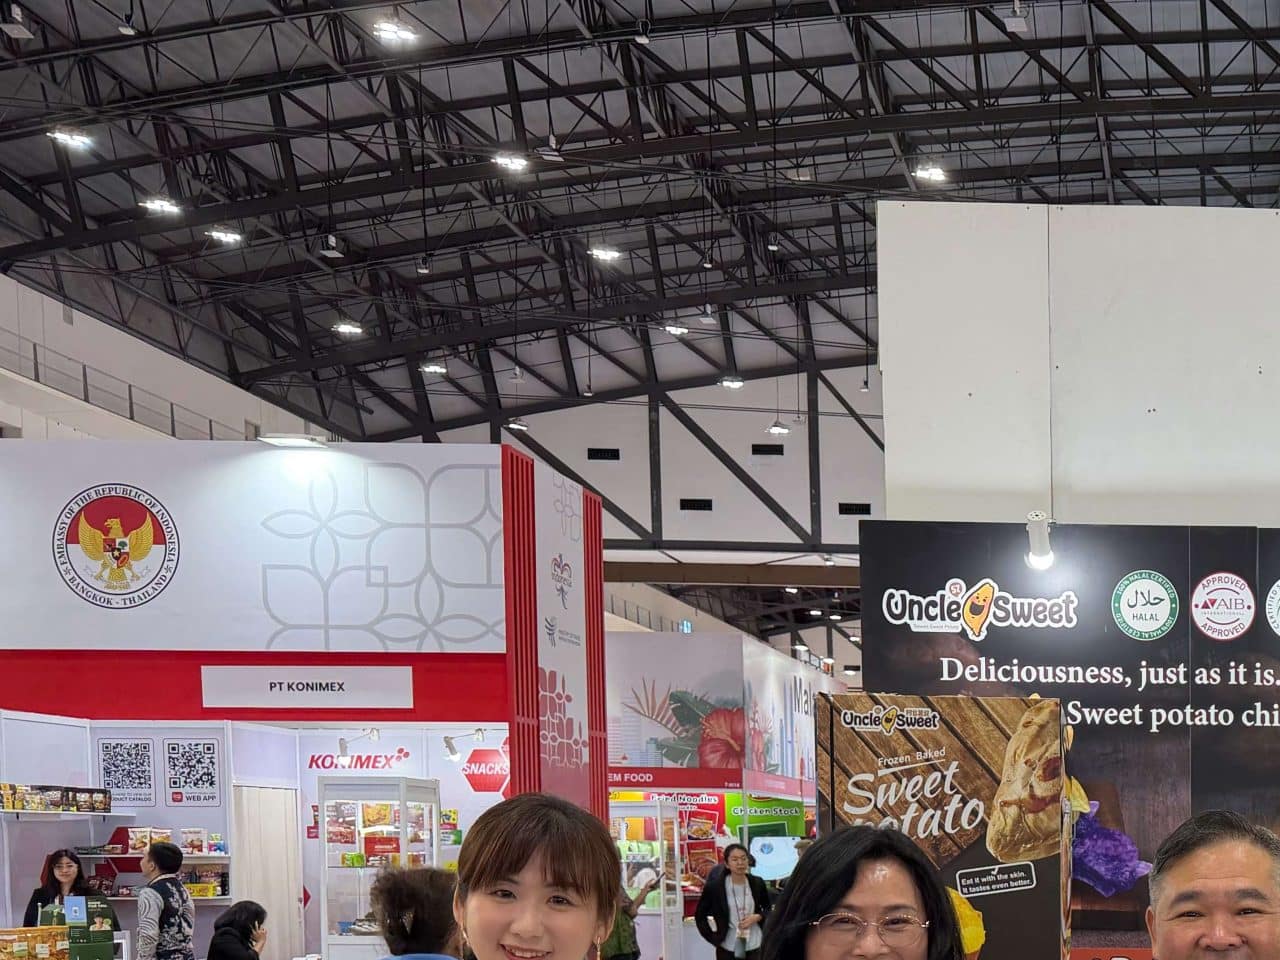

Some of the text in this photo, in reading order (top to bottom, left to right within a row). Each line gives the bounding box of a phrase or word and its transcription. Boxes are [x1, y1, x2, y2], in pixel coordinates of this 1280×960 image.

[57, 487, 176, 565] EMBASSY OF THE REPUBLIC OF INDONESIA
[69, 574, 167, 606] BANGKOK THAILAND
[1129, 572, 1150, 581] HALAL
[1151, 573, 1175, 598] CERTIFIED
[1201, 576, 1246, 591] APPROVED
[1127, 590, 1165, 608] حلال
[1216, 600, 1245, 609] AIB
[886, 591, 1075, 625] Uncle Sweet
[1268, 589, 1280, 629] CERTIFIED
[1132, 613, 1159, 621] HALAL
[1201, 622, 1246, 638] APPROVED
[940, 657, 1131, 687] Deliciousness,
[1138, 660, 1187, 691] just
[1195, 667, 1221, 684] as
[1228, 662, 1248, 685] it
[269, 682, 345, 692] PT KONIMEX
[843, 711, 938, 728] Uncle Sweet
[1067, 701, 1143, 726] Sweet
[1150, 704, 1234, 733] potato
[878, 747, 946, 766] Frozen Baked
[462, 763, 509, 775] SNACKS
[624, 774, 653, 782] FOOD
[843, 761, 959, 815] Sweet
[679, 795, 718, 803] Noodles
[773, 807, 800, 815] Stock
[961, 878, 973, 886] Eat
[1010, 870, 1027, 878] skin.
[992, 882, 1009, 890] even
